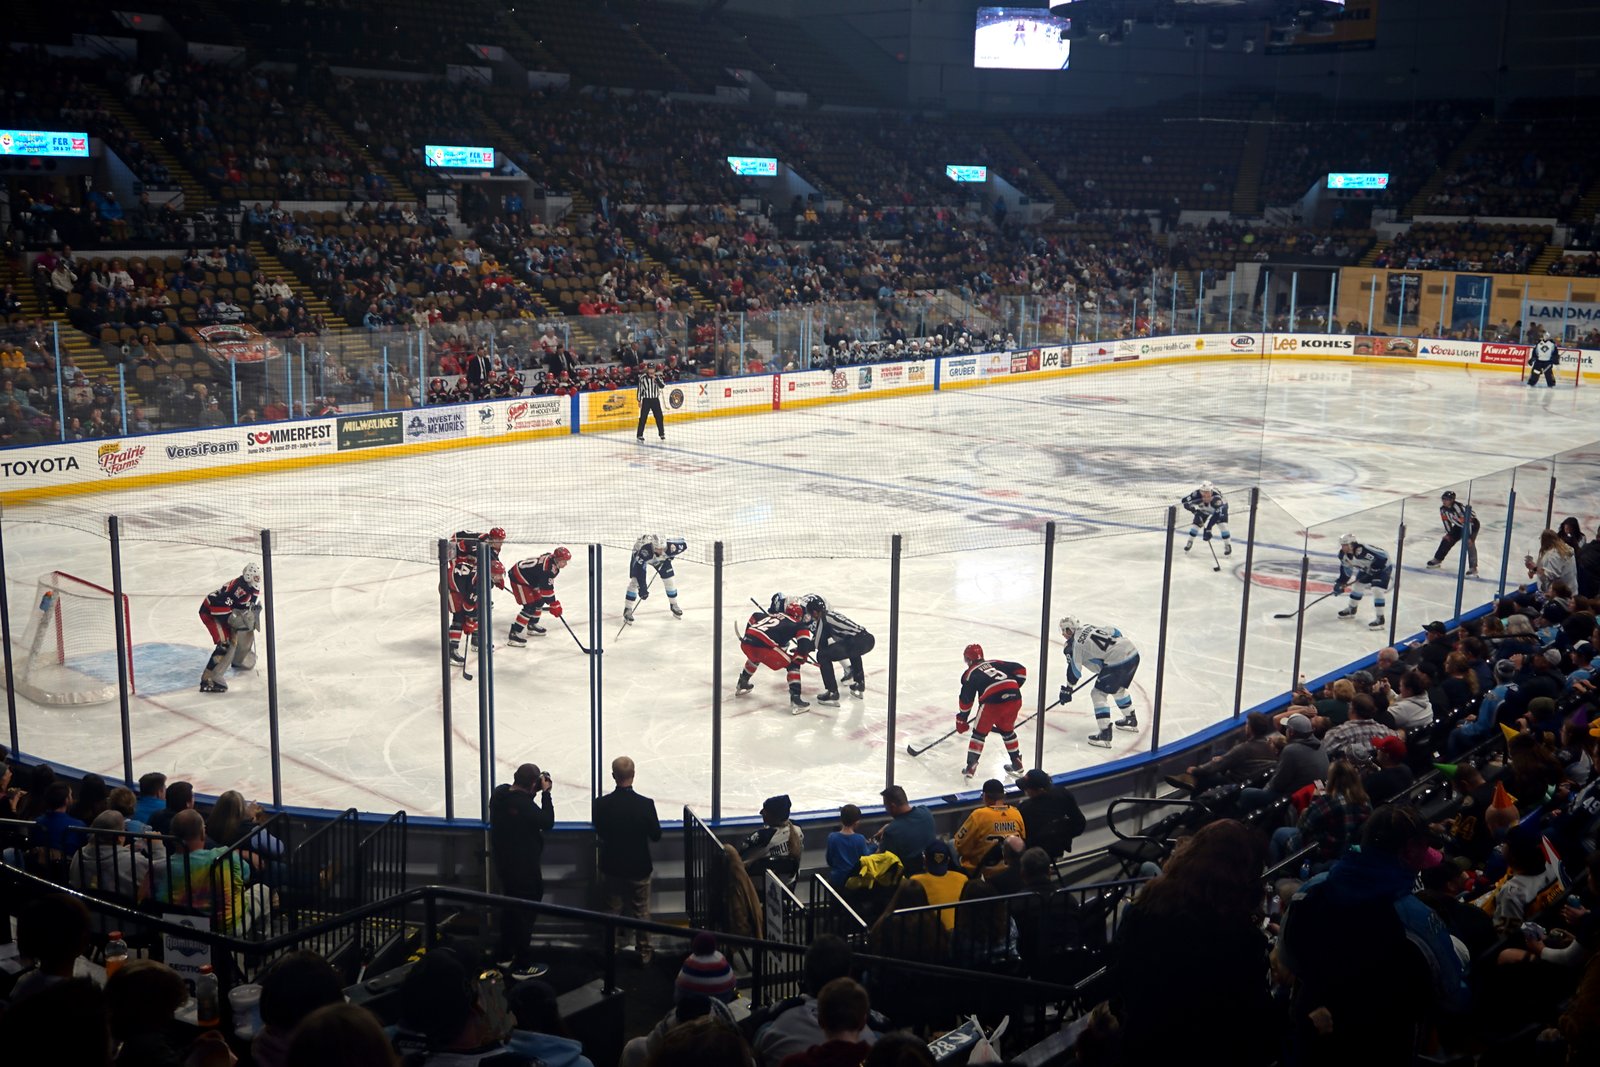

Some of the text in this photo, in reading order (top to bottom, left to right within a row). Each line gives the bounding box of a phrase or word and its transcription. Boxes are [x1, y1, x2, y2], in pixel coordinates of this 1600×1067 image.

[1273, 336, 1298, 351] Lee
[1301, 339, 1352, 349] KOHL'S
[1042, 351, 1059, 367] Lee
[1456, 349, 1479, 358] LIGHT
[1559, 354, 1593, 364] ndmrk
[949, 366, 976, 377] GRUBER
[342, 416, 399, 433] MILWAUKEE
[427, 415, 453, 423] INVEST
[427, 420, 465, 434] MEMORIES
[100, 444, 146, 468] Prairie
[166, 440, 240, 460] VersiFoam
[1, 456, 79, 477] TOYOTA
[110, 458, 140, 475] Farms
[994, 821, 1016, 832] RINNE
[169, 963, 202, 973] SECTIO
